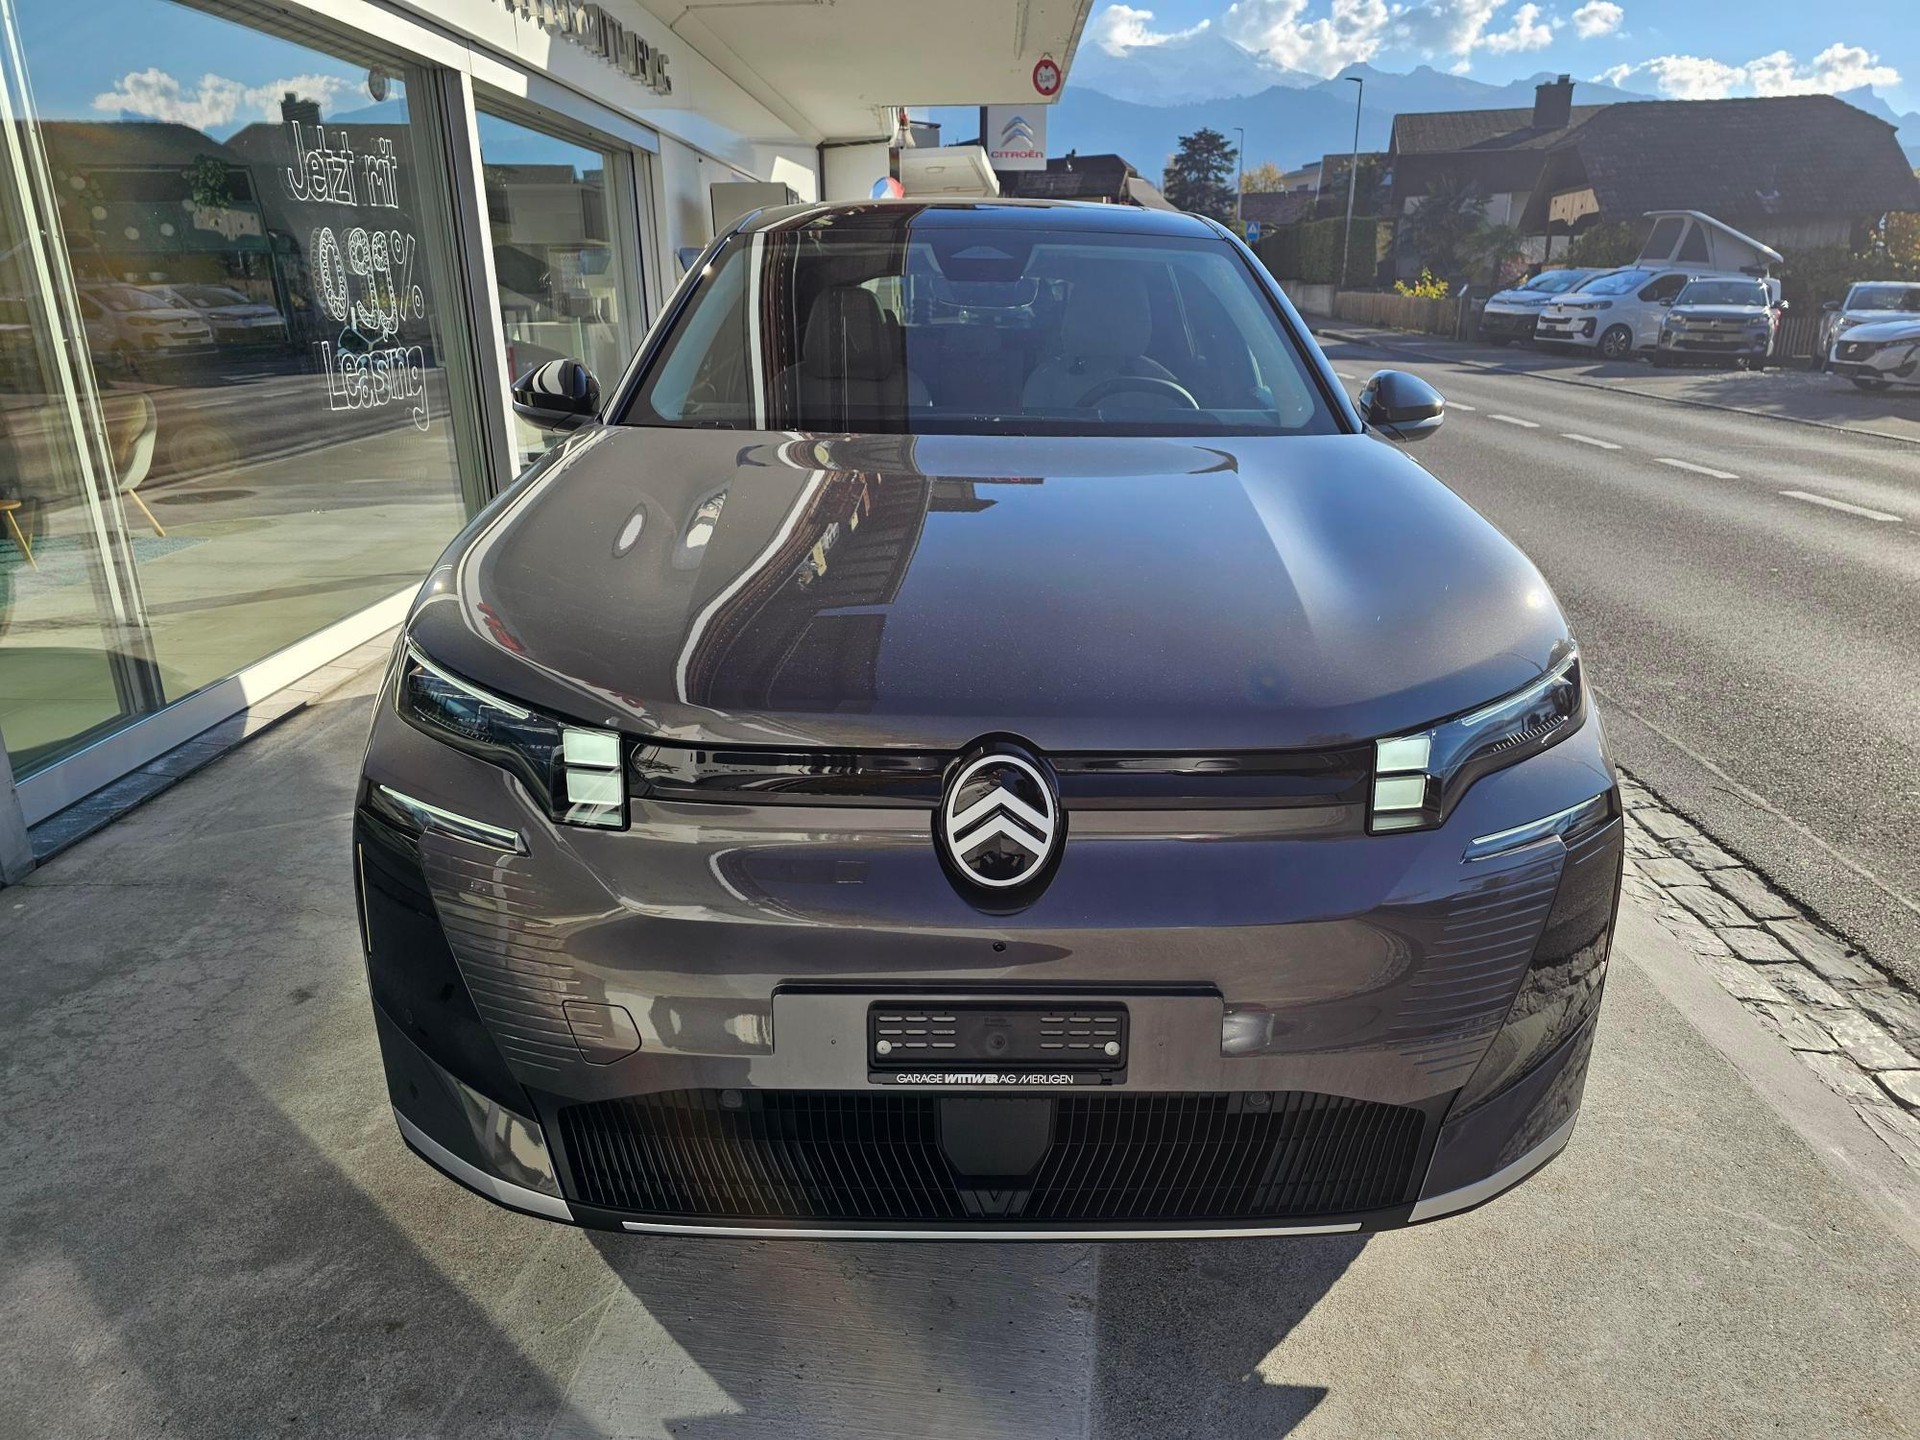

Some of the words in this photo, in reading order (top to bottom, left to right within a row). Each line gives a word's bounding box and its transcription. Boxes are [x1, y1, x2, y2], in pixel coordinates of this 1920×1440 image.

[287, 120, 358, 207] Jetzt
[364, 136, 400, 209] mit
[321, 329, 430, 432] Leasing
[896, 1073, 943, 1084] GARAGE
[944, 1073, 999, 1084] WITTWER
[998, 1074, 1017, 1084] AG
[1018, 1074, 1074, 1084] MERLIGEN
